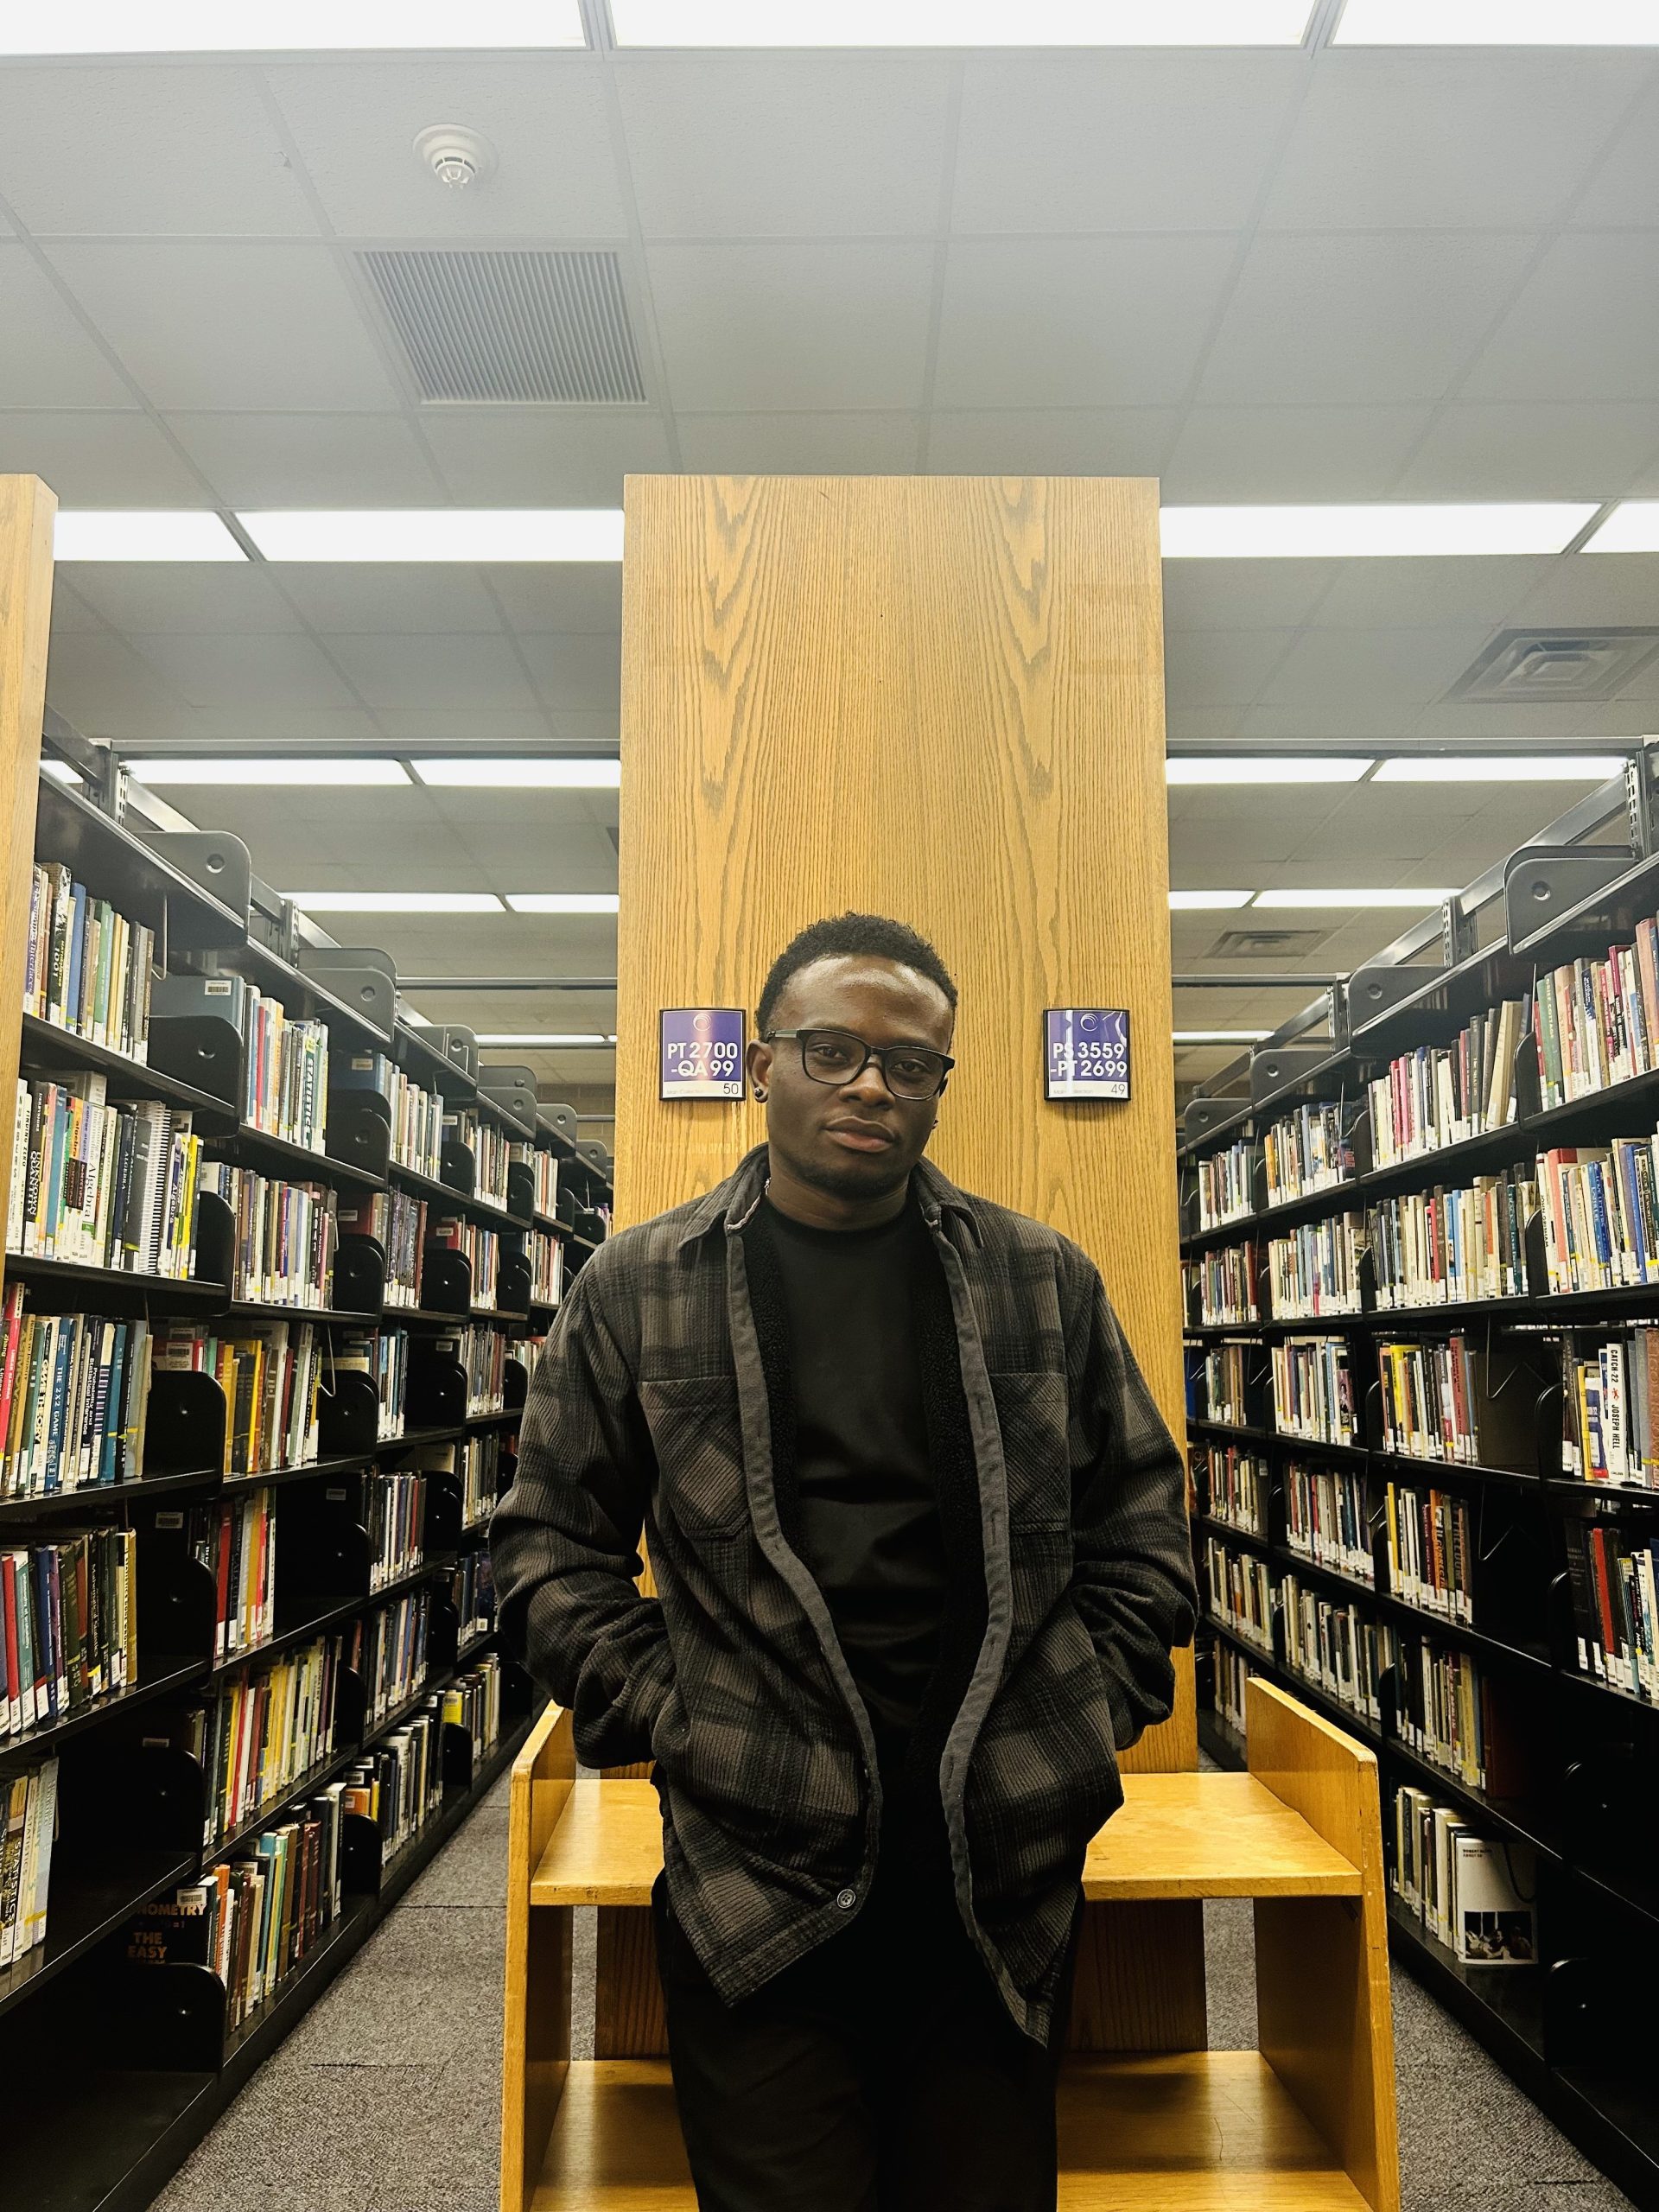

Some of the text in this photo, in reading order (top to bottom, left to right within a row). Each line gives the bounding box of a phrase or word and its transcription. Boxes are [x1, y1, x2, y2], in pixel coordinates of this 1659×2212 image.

[668, 1042, 738, 1059] PT 2700
[671, 1059, 734, 1077] -QA 99
[1053, 1041, 1125, 1059] PS 3559
[1080, 1059, 1128, 1077] 2699
[305, 1057, 314, 1134] STATISTICS
[723, 1083, 739, 1095] 50
[1110, 1084, 1126, 1095] 49
[27, 1150, 37, 1215] QUANTITY
[30, 1151, 41, 1216] UNKNOWN
[84, 1163, 97, 1217] Algebra
[121, 1151, 130, 1190] ALGEBRA
[169, 1183, 178, 1224] Algebra
[1, 1333, 10, 1357] Zhang
[13, 1329, 27, 1400] ASIMOV
[35, 1358, 49, 1445] GAME THEORY
[83, 1357, 94, 1435] Statistical Inference
[89, 1367, 98, 1408] Probability
[1611, 1404, 1620, 1431] JOSEPH
[1436, 1540, 1446, 1588] CORRECTI
[232, 1553, 241, 1618] CALCULUS
[22, 1815, 33, 1876] STATISTICS
[9, 1841, 22, 1923] STATISTICS
[138, 1903, 207, 1916] NOMETRY
[127, 1946, 168, 1959] EASY
[134, 1931, 162, 1944] THE
